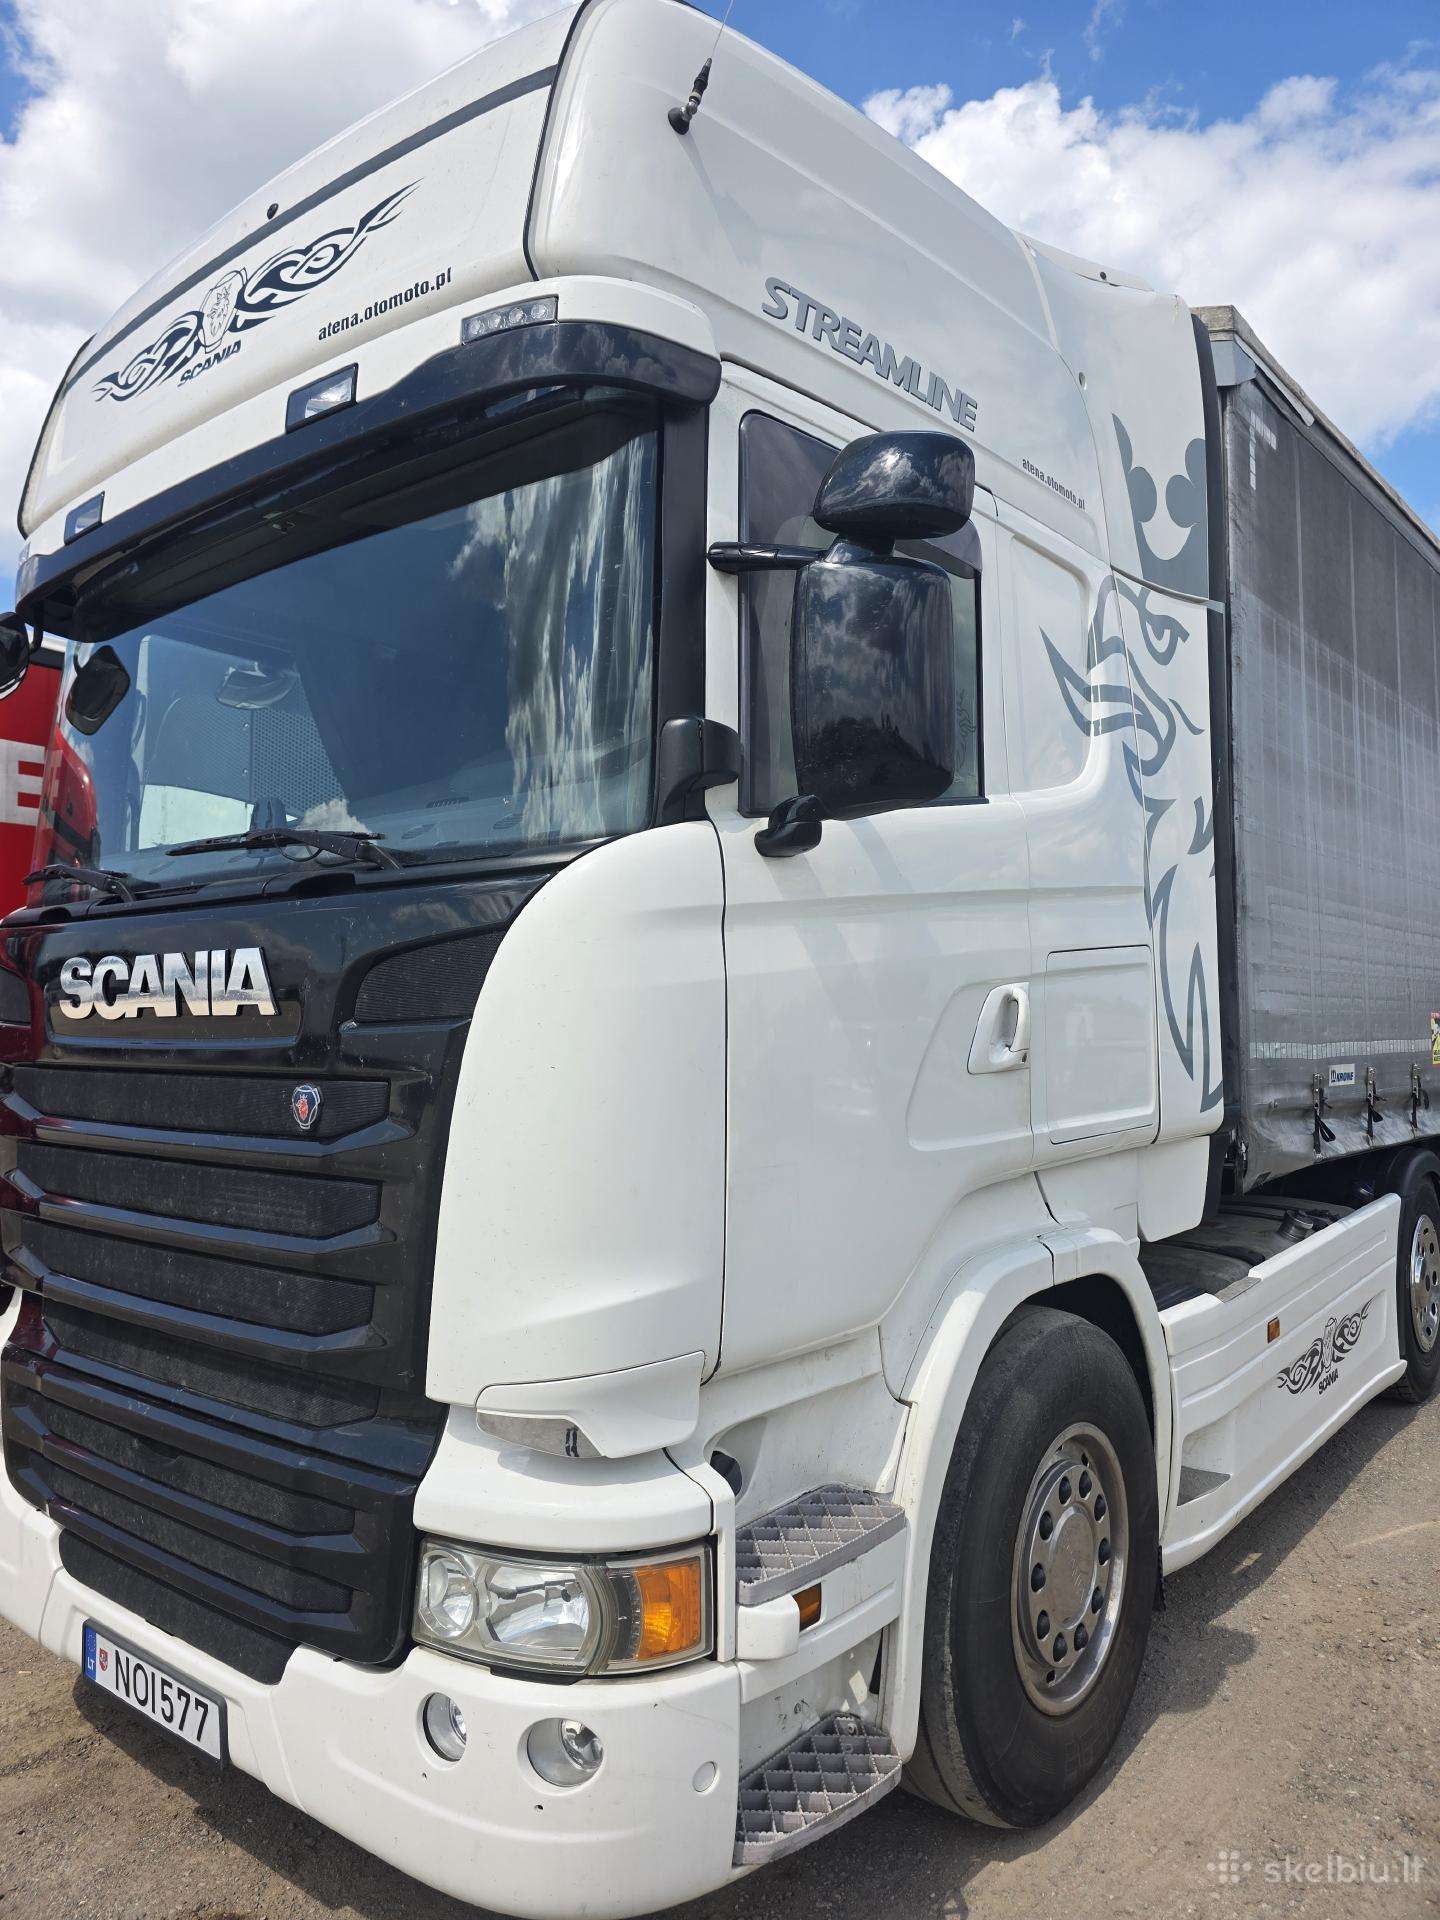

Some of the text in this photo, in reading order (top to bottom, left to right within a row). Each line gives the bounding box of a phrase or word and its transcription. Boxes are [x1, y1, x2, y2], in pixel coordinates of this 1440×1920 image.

[318, 267, 452, 341] atena.otomoto.pl
[177, 339, 242, 388] SCANIA
[762, 277, 978, 432] STREAMLINE
[1021, 458, 1086, 511] atena.otomoto.pl
[59, 947, 279, 1021] SCANIA
